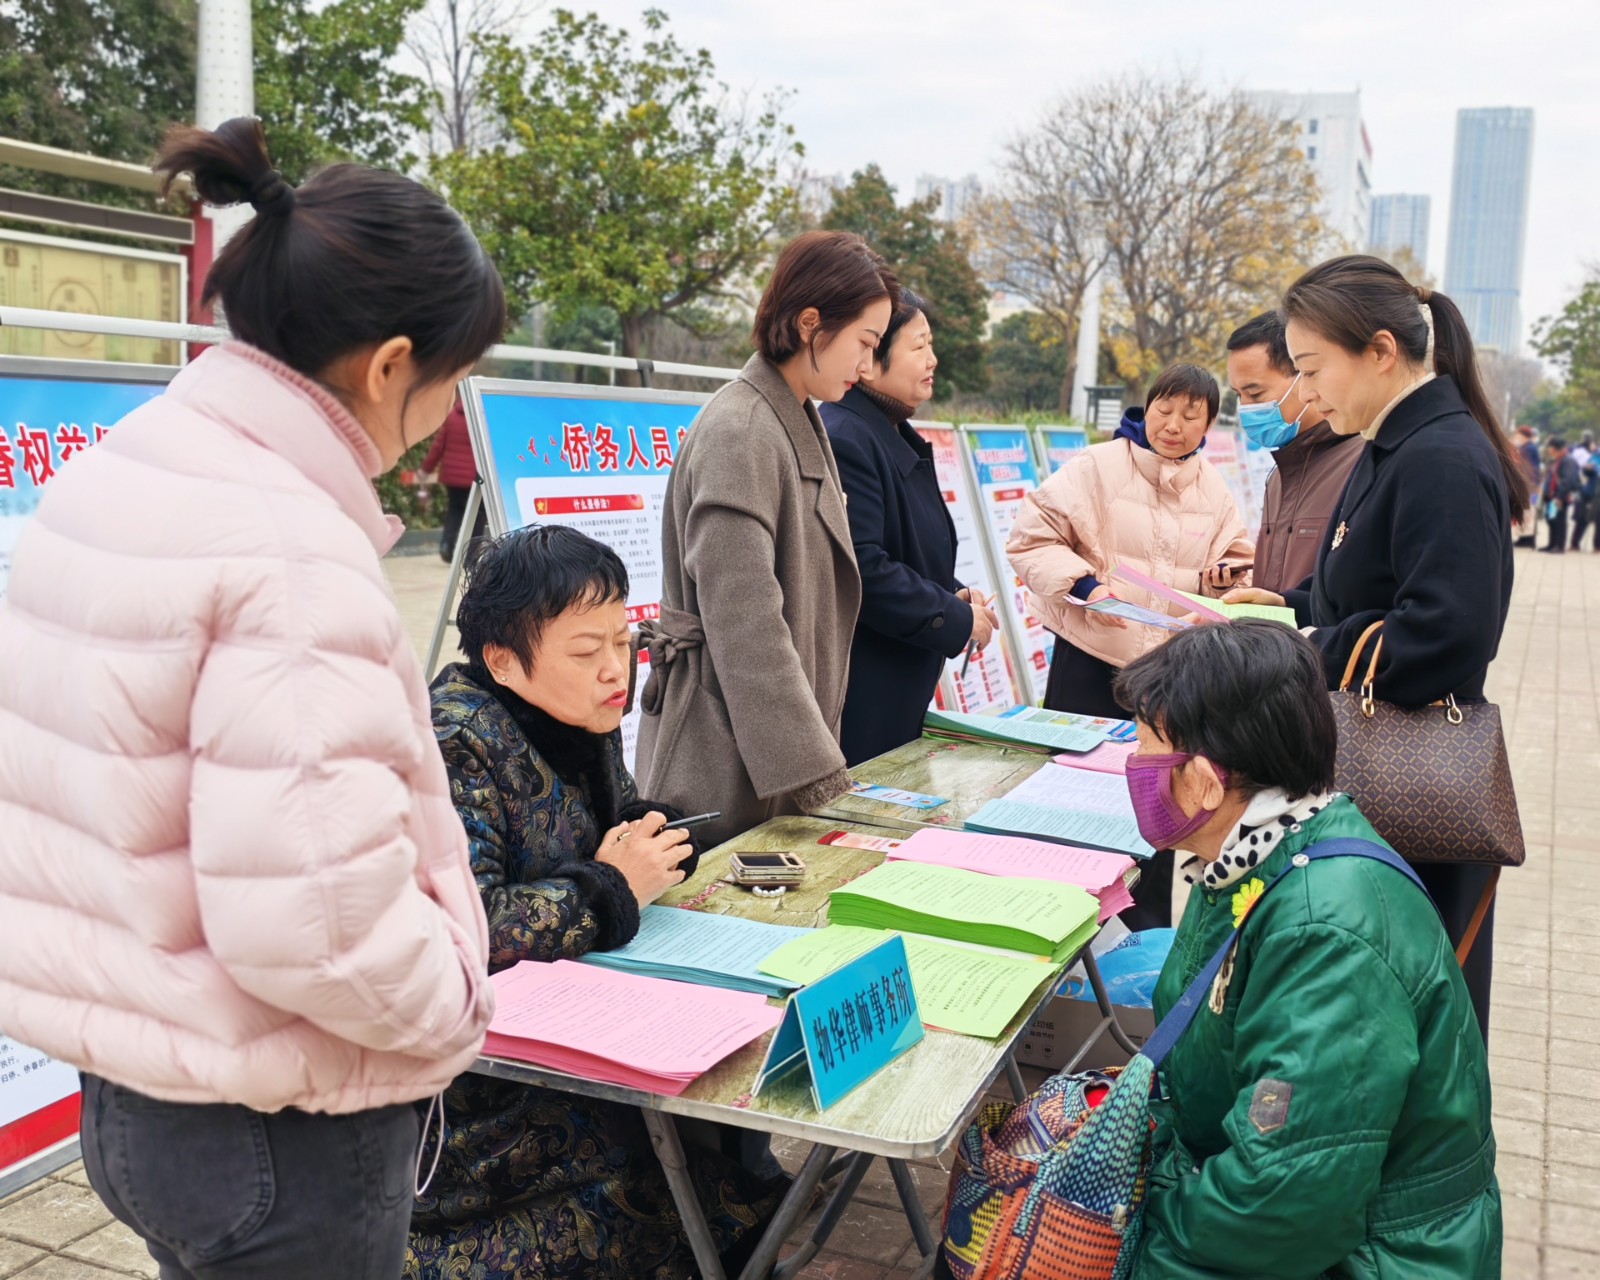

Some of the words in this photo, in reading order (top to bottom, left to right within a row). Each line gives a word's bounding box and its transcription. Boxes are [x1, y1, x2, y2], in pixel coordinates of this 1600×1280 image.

[562, 424, 687, 470] 侨务人员
[813, 966, 912, 1074] 物华律师事务所
